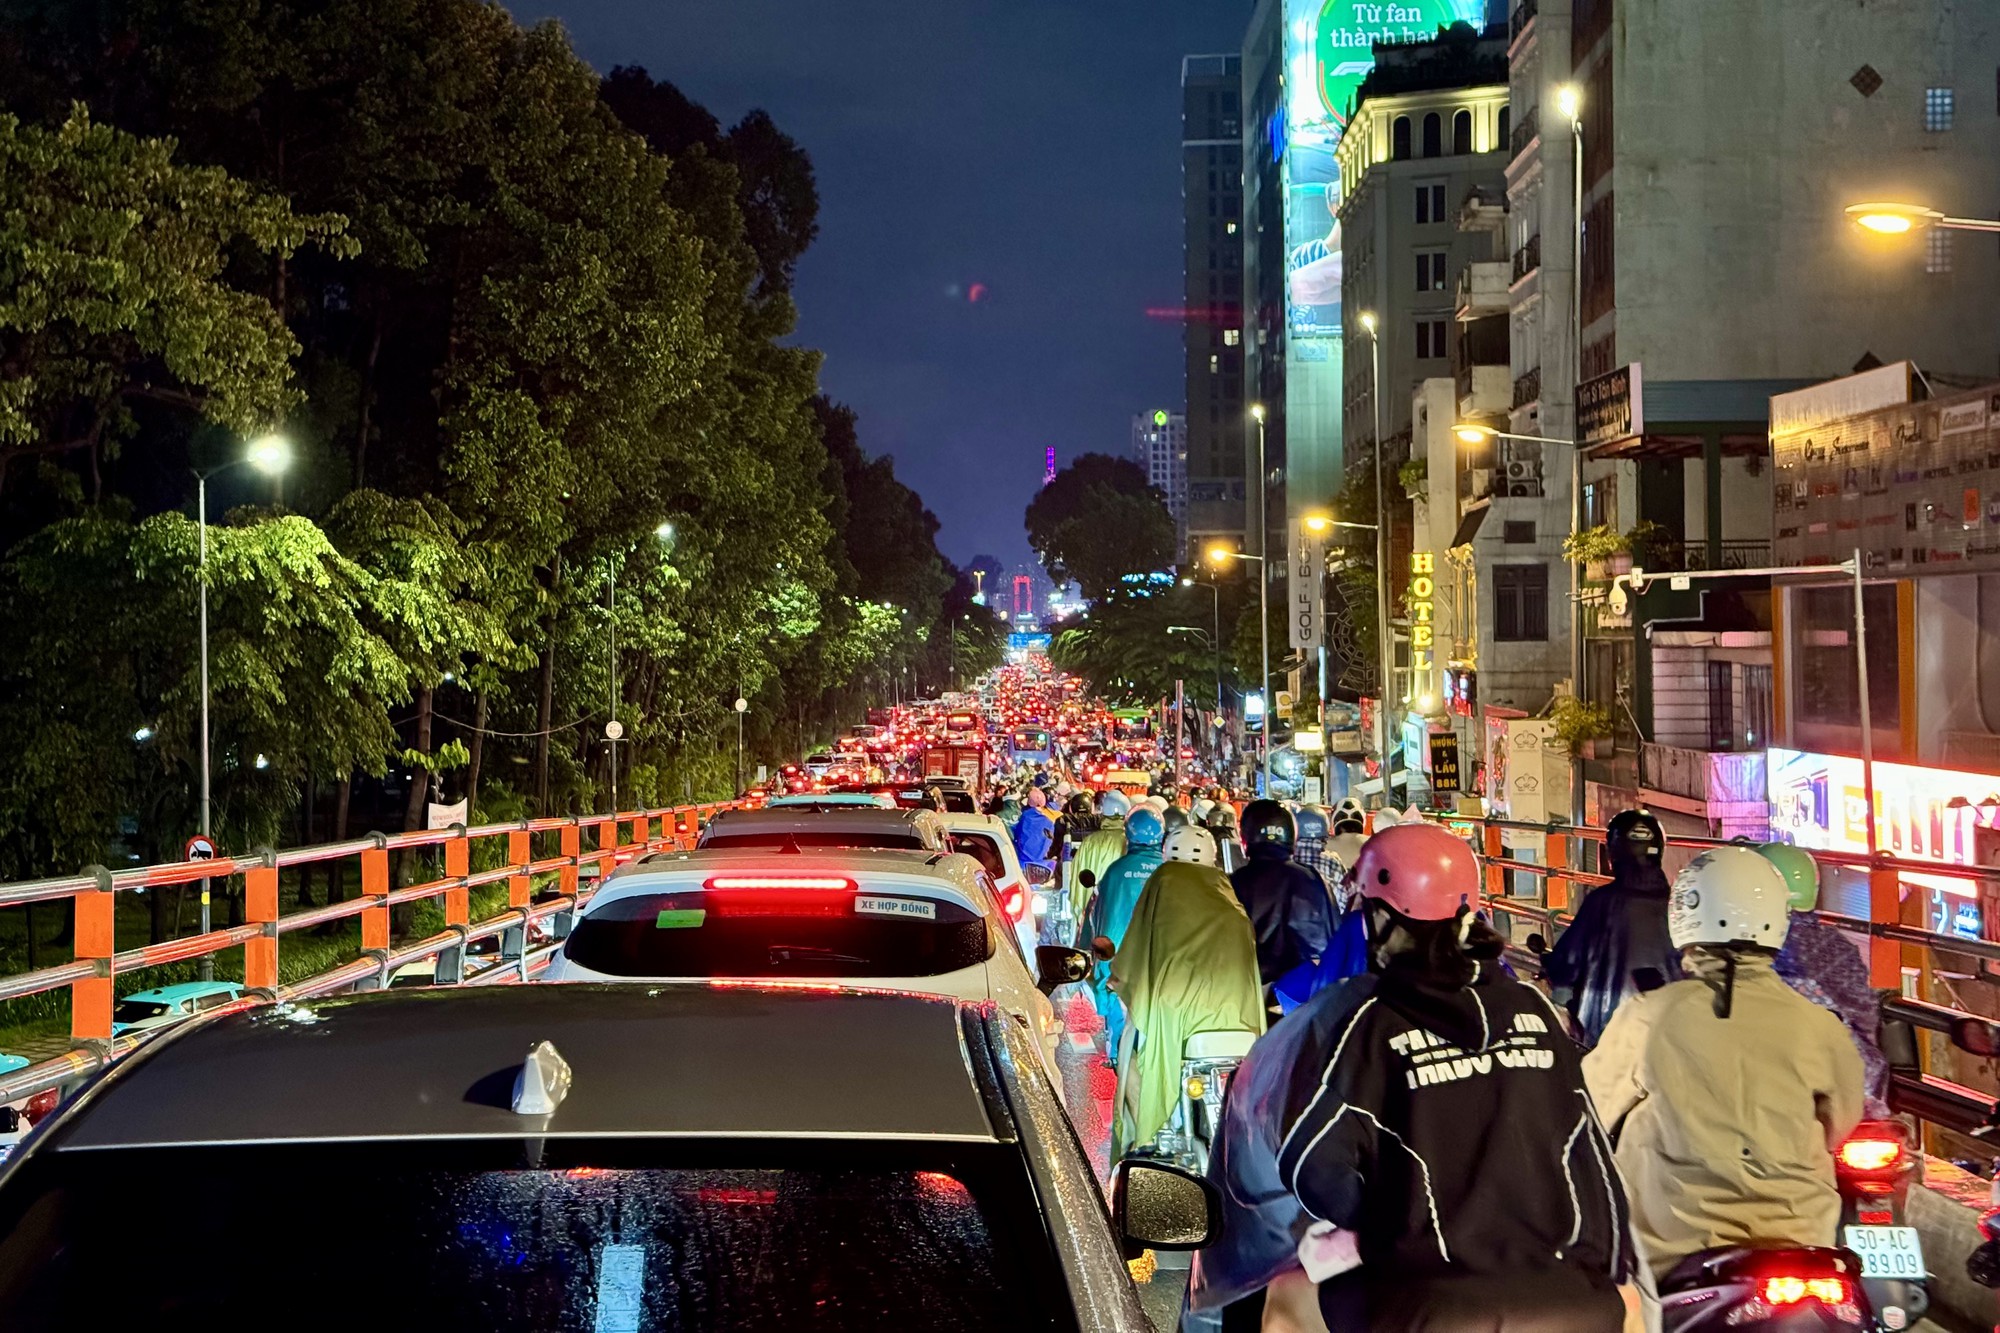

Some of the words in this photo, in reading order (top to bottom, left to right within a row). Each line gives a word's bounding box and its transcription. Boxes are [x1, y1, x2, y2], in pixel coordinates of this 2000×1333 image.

[1352, 3, 1382, 23] Từ
[1385, 2, 1422, 23] fan
[1330, 26, 1396, 47] thành
[1299, 594, 1311, 641] GOLF
[1412, 553, 1434, 671] HOTEL
[861, 900, 875, 910] XE
[1856, 1229, 1909, 1250] 50-AC
[1861, 1253, 1919, 1274] 89.09
